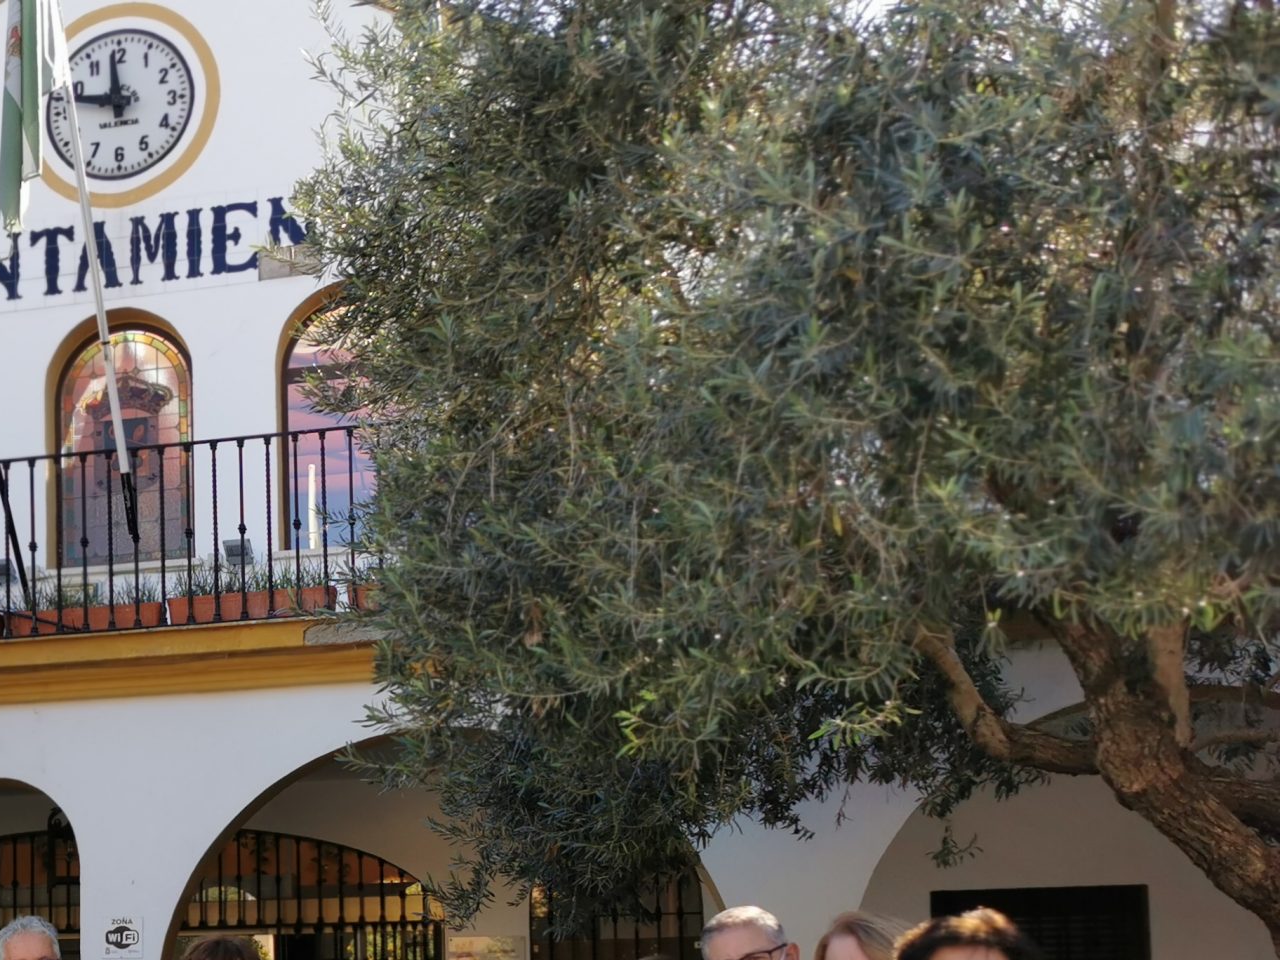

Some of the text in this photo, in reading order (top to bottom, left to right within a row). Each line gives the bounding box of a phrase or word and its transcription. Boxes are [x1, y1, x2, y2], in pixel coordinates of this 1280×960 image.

[89, 60, 100, 76] 11
[158, 68, 169, 84] 2
[167, 90, 177, 106] 3
[159, 113, 170, 129] 4
[90, 142, 100, 159] 7
[138, 135, 150, 151] 5
[114, 147, 124, 162] 6
